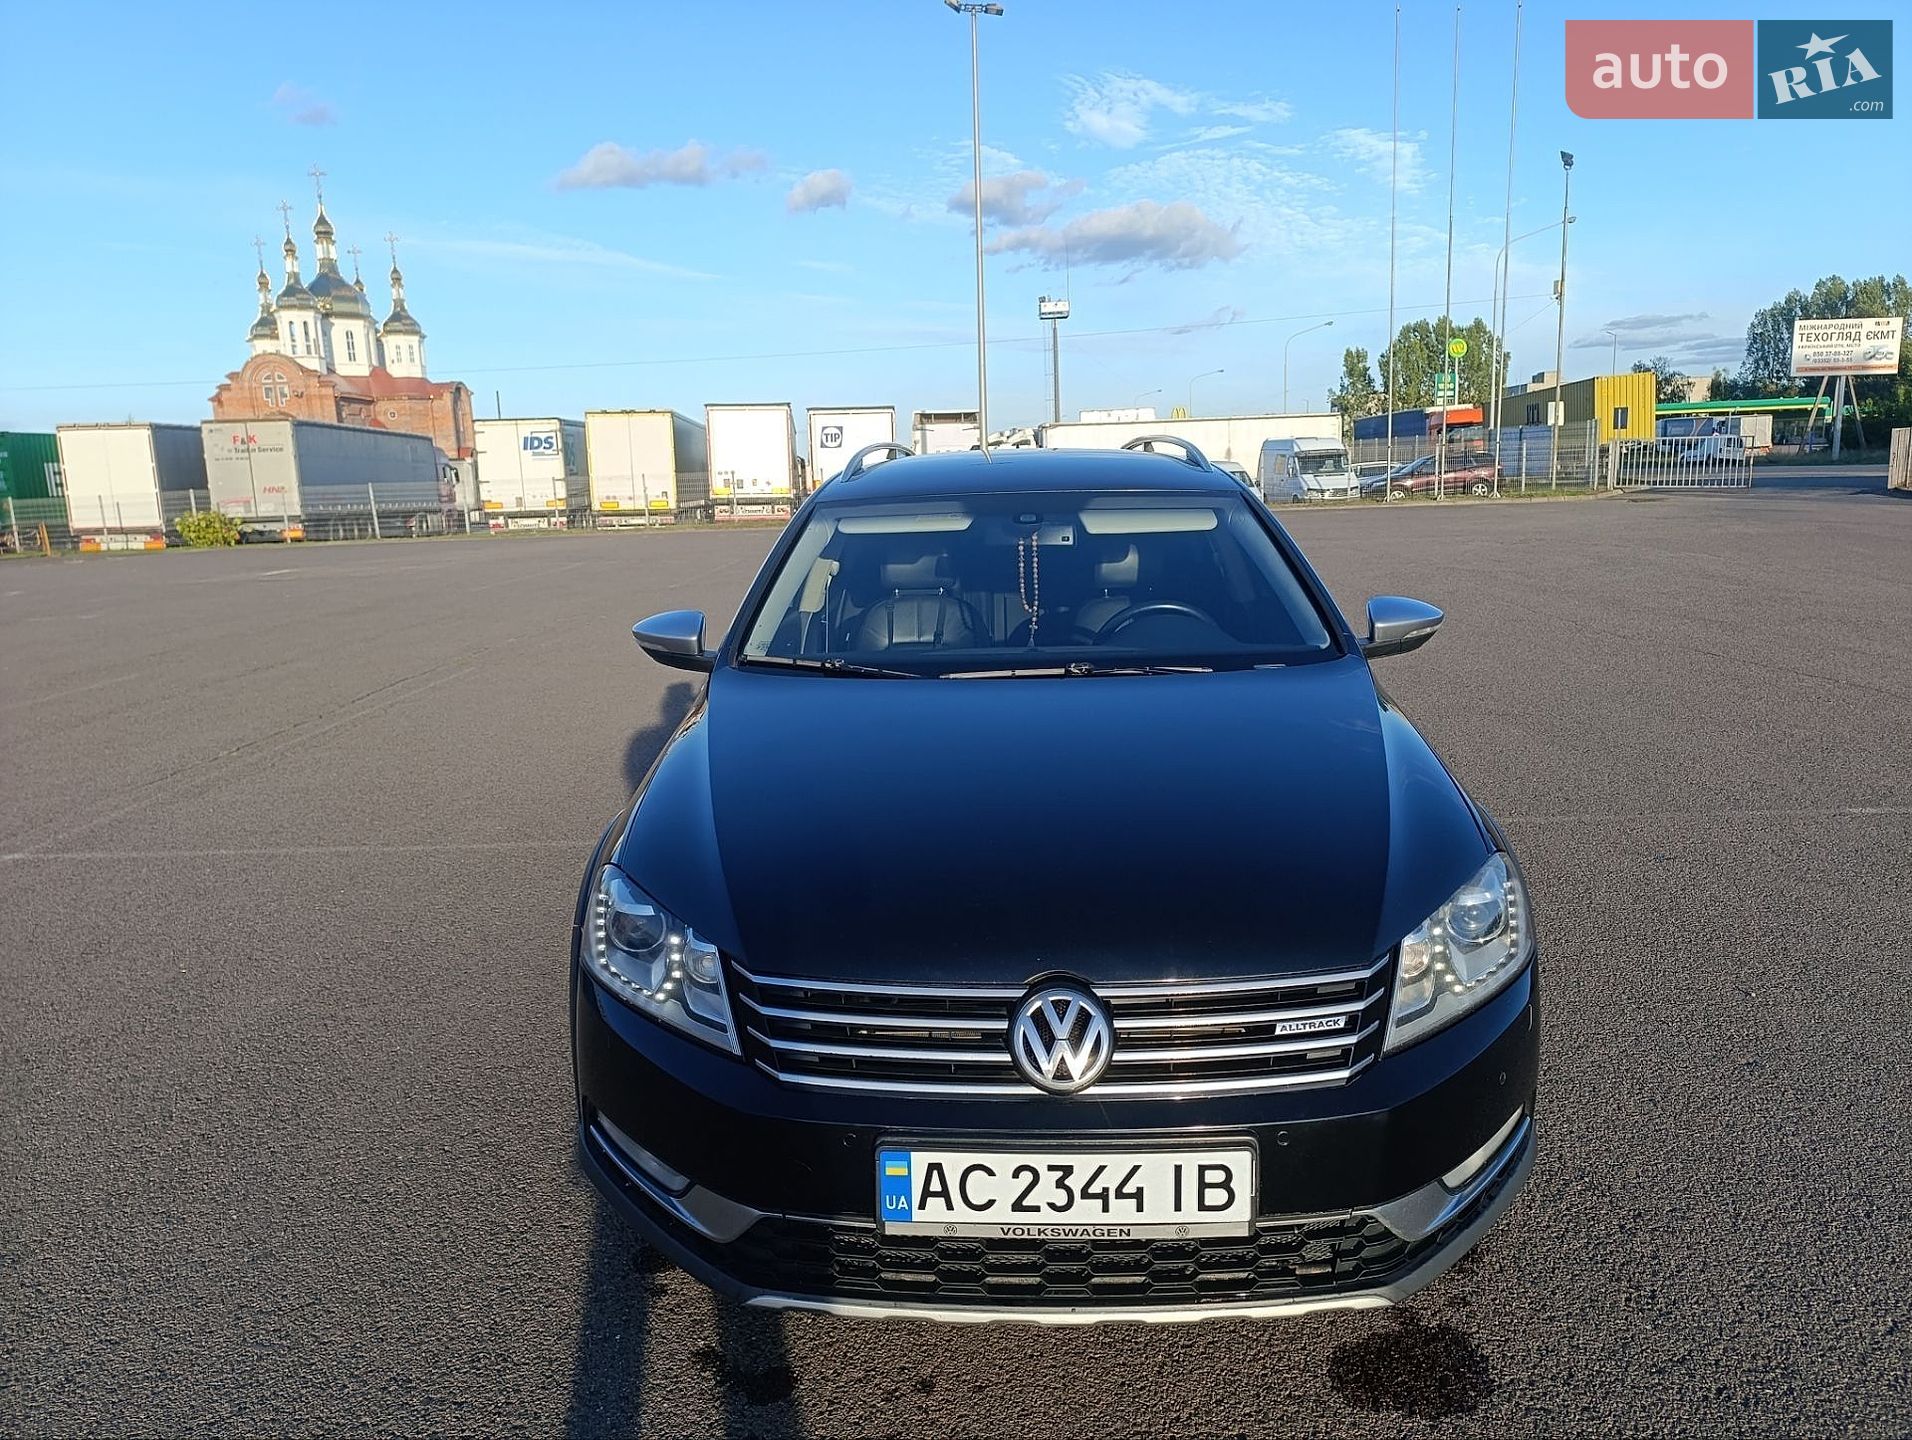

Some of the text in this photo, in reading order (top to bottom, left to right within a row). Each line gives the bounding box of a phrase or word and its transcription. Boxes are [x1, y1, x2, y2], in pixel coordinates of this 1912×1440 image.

[1798, 321, 1863, 331] МІЖНАРОДНИЙ
[1798, 330, 1897, 343] ТЕХОГЛЯД ЄКМТ
[523, 435, 554, 452] IDS
[823, 432, 841, 443] TIP
[1279, 1017, 1342, 1033] ALLTRACK
[917, 1162, 1236, 1213] AC 2344 IB
[885, 1195, 909, 1211] UA
[1000, 1226, 1132, 1239] VOLKSWAGEN
